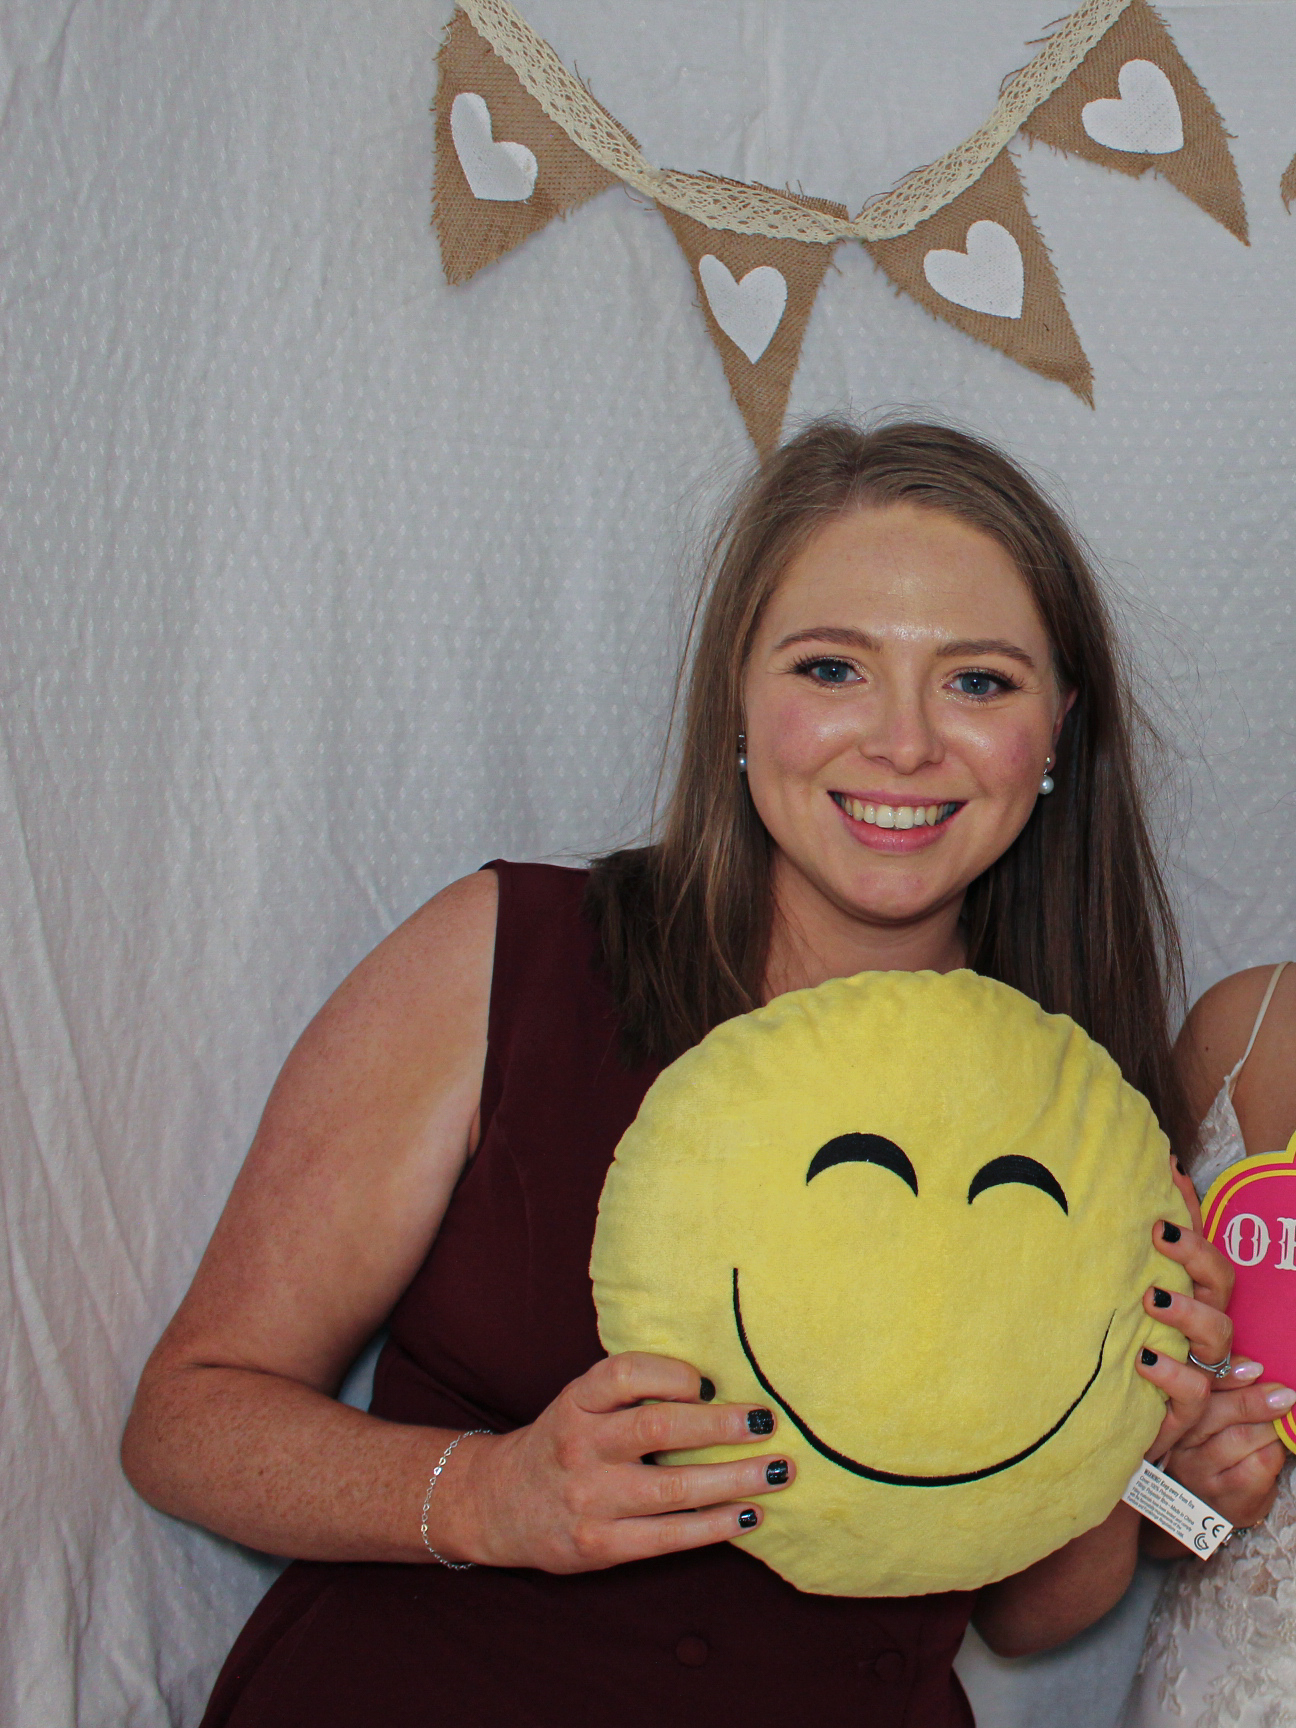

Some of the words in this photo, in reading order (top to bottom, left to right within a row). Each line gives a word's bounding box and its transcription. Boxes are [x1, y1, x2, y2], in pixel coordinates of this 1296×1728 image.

[1160, 1480, 1169, 1491] Keep
[1169, 1488, 1179, 1498] away
[1179, 1493, 1188, 1504] from
[1170, 1504, 1180, 1515] Made
[1184, 1515, 1194, 1525] China
[1201, 1516, 1225, 1538] CE
